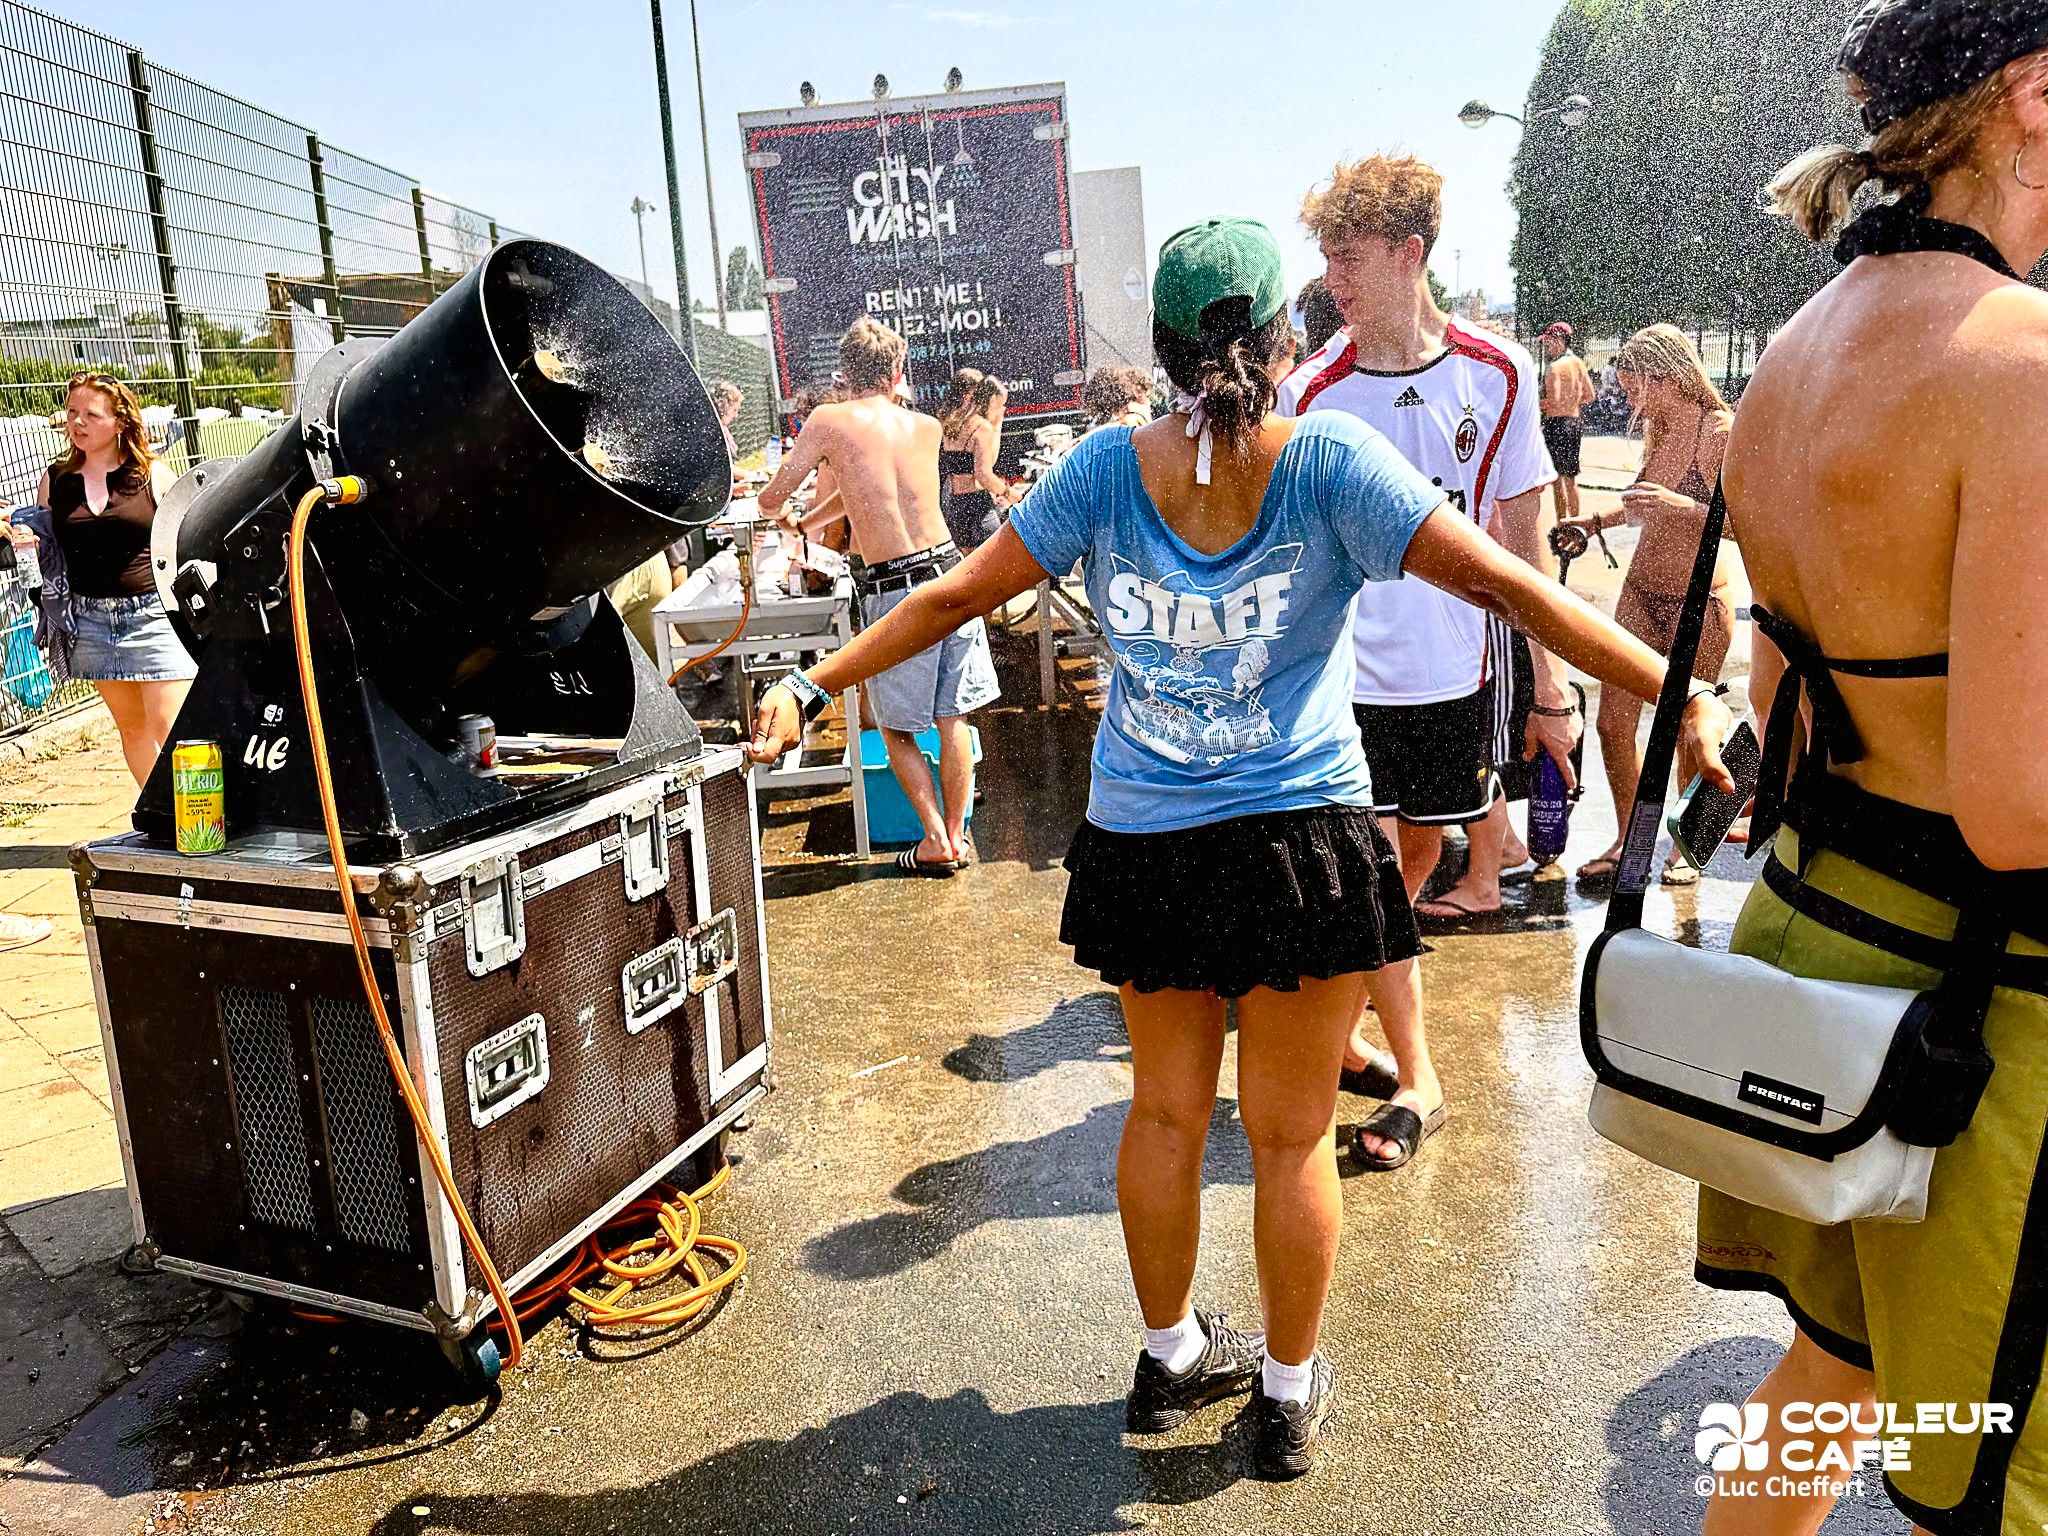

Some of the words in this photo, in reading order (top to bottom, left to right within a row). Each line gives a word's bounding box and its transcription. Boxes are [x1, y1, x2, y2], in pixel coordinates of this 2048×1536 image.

[876, 154, 907, 173] THE
[853, 165, 945, 208] CITY
[846, 200, 957, 244] WASH
[865, 288, 922, 313] RENT
[934, 282, 970, 308] ME
[1393, 398, 1425, 408] adidas
[887, 550, 930, 570] Supreme
[1107, 572, 1292, 649] STAFF
[197, 772, 218, 790] RIO
[1747, 1084, 1812, 1111] FREITAG
